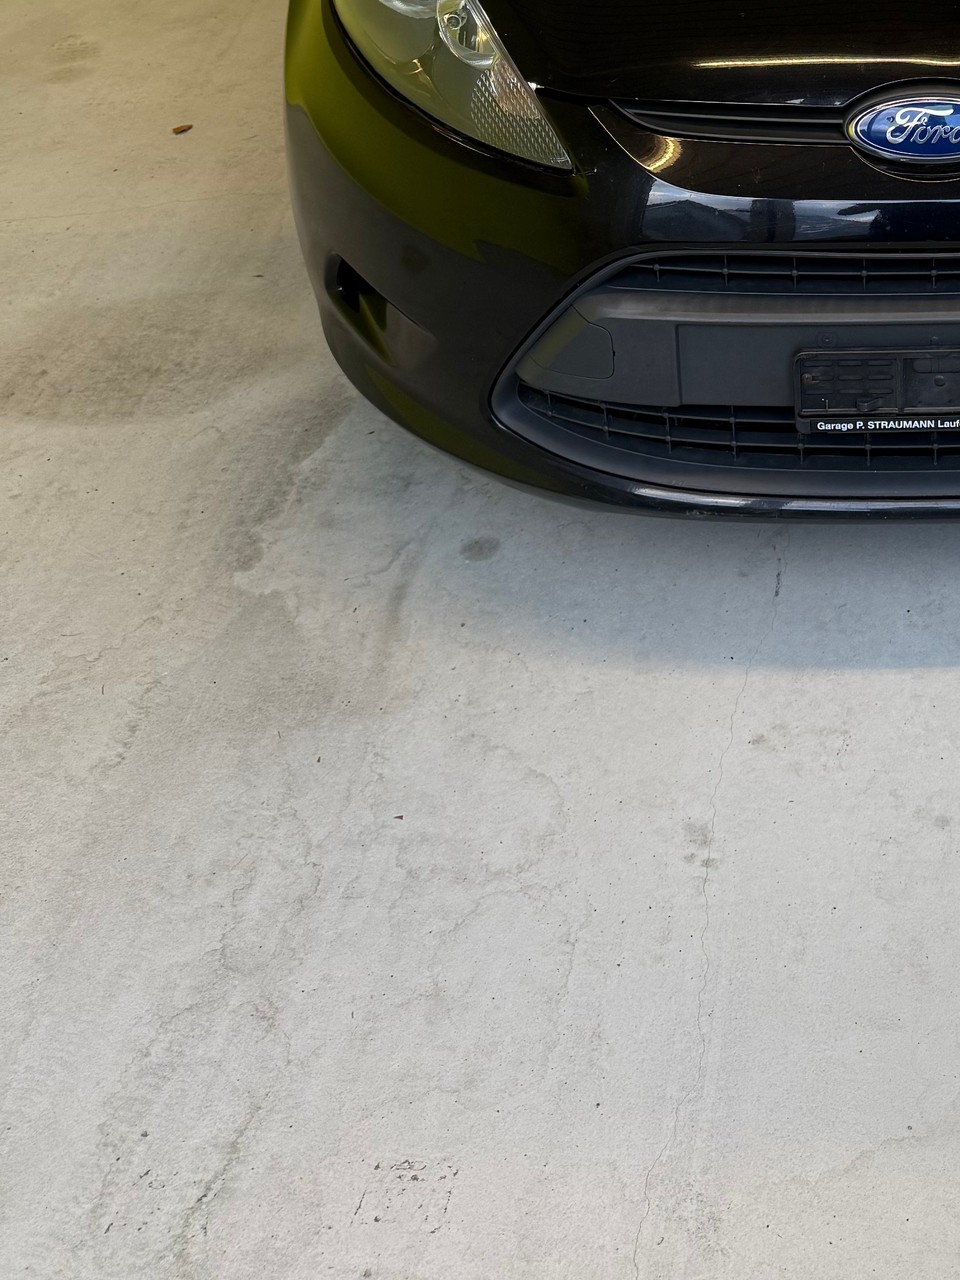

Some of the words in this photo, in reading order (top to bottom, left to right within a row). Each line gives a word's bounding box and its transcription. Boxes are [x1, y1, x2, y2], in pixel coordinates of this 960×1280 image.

[816, 421, 854, 431] Garage
[856, 421, 865, 430] P.
[867, 419, 935, 430] STRAUMANN
